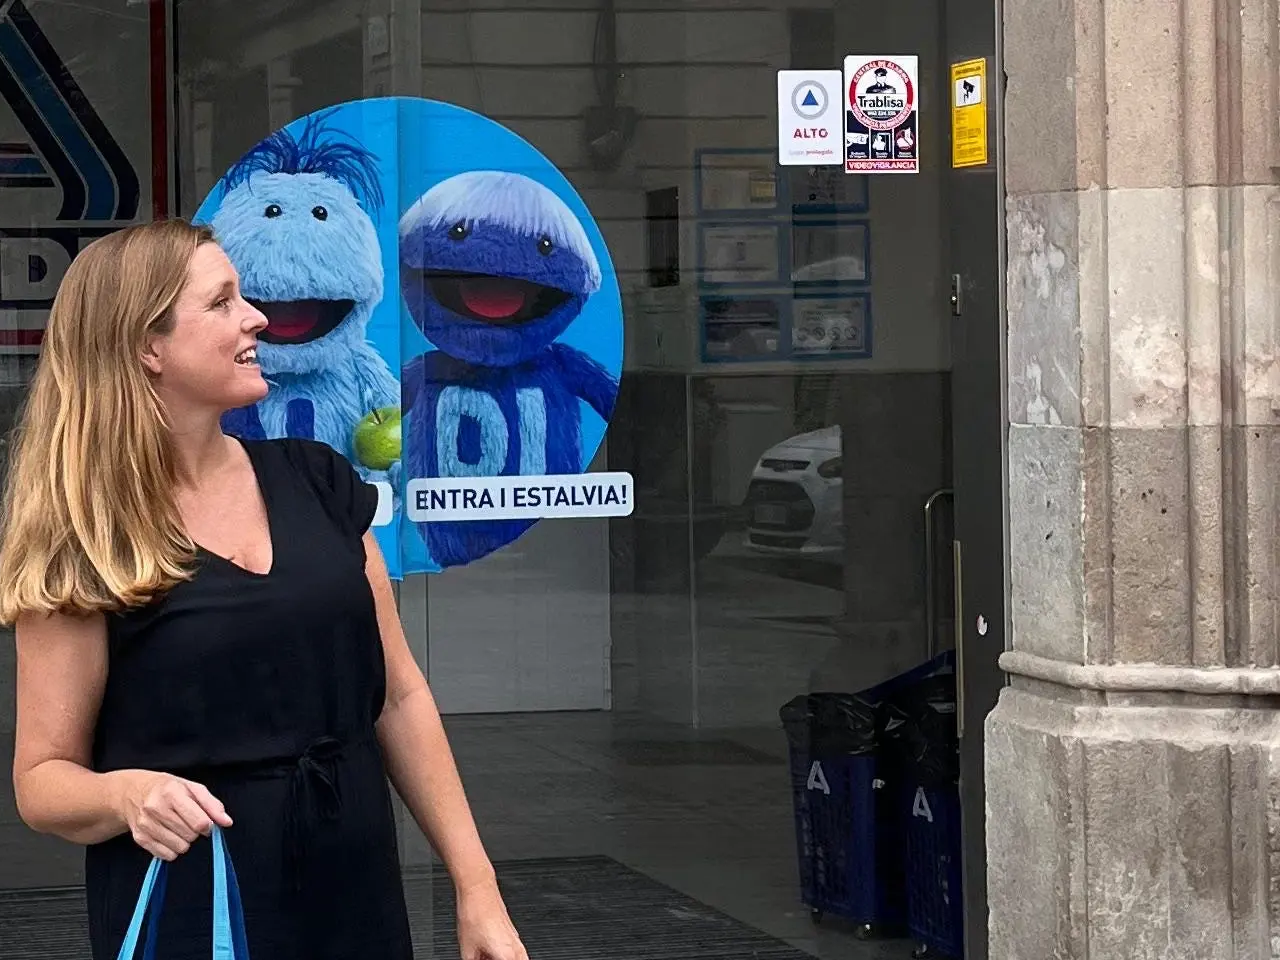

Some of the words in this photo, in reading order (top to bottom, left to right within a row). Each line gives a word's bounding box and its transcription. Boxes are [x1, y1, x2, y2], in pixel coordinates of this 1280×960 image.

[857, 96, 904, 108] Trablisa
[793, 128, 829, 139] ALTO
[436, 385, 548, 478] DI
[415, 488, 495, 510] ENTRA
[500, 487, 505, 508] I
[513, 484, 627, 508] ESTALVIA!
